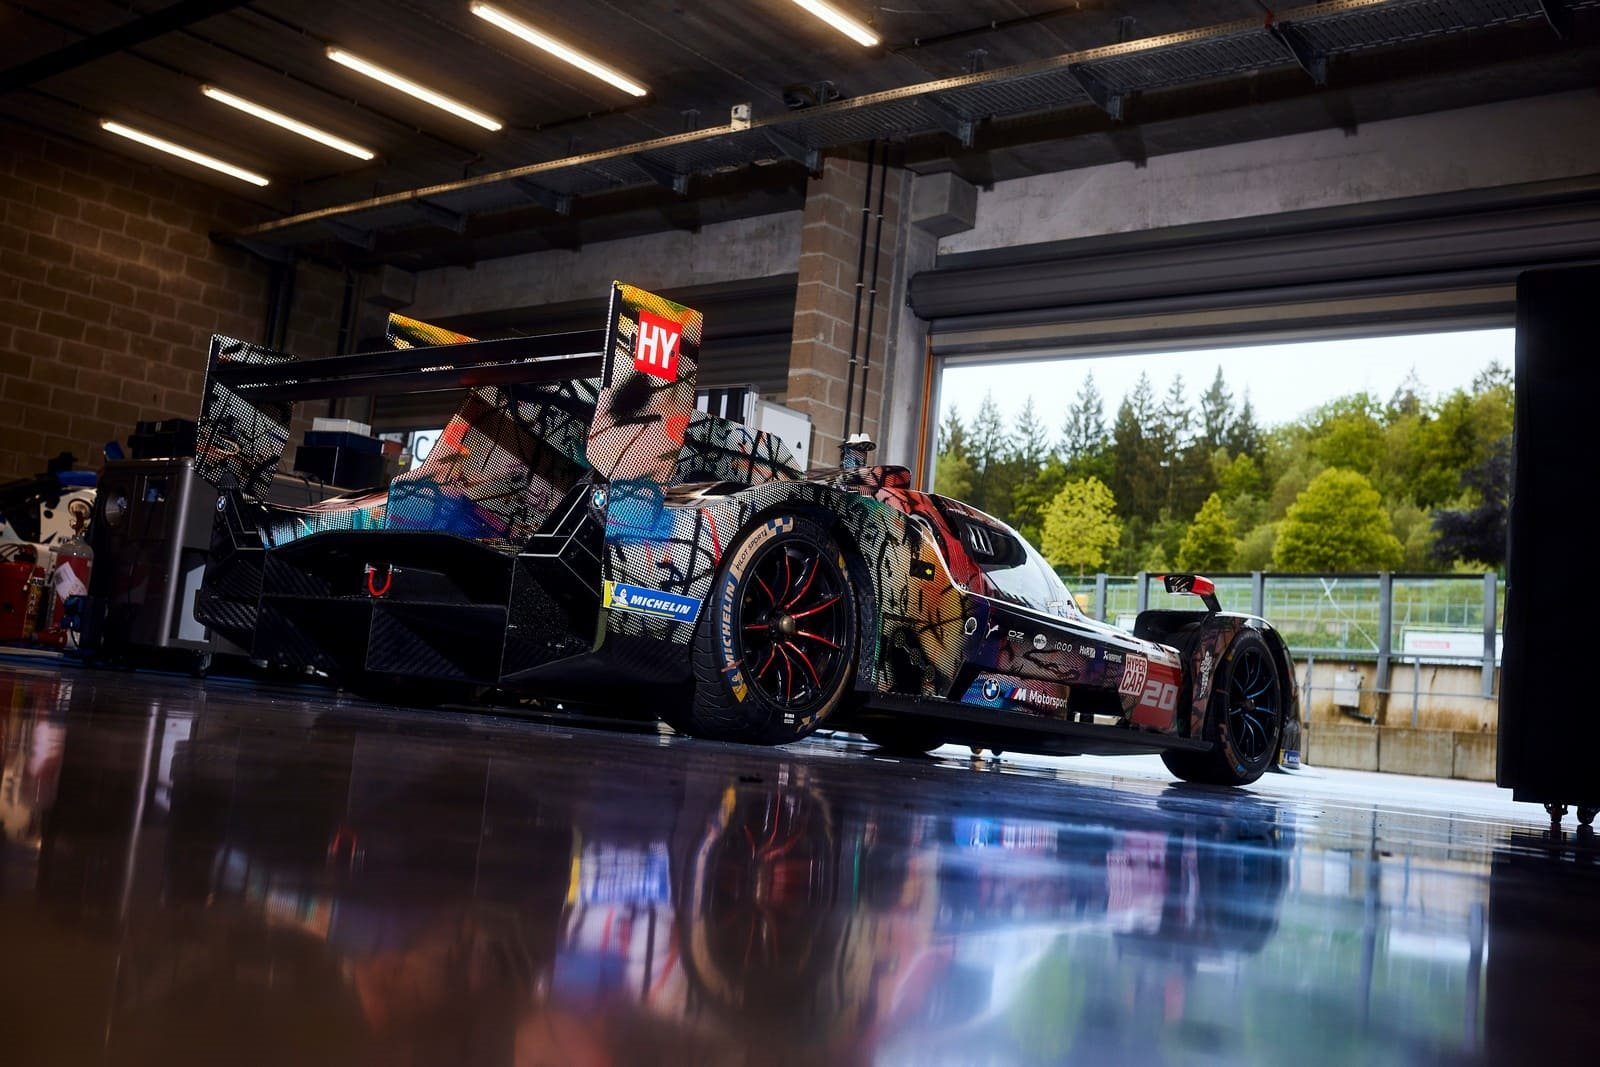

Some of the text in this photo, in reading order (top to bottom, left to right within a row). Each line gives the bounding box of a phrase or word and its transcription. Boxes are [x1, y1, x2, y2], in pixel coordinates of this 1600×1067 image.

[637, 321, 679, 369] HY
[735, 531, 765, 571] PILOT SPORT
[630, 595, 692, 614] MICHELIN
[722, 581, 737, 669] MICHELIN
[1008, 629, 1024, 639] OZ
[1126, 656, 1146, 673] HYPER
[1121, 671, 1144, 693] CAR
[1029, 690, 1068, 709] Motorsport
[1140, 680, 1179, 711] 20
